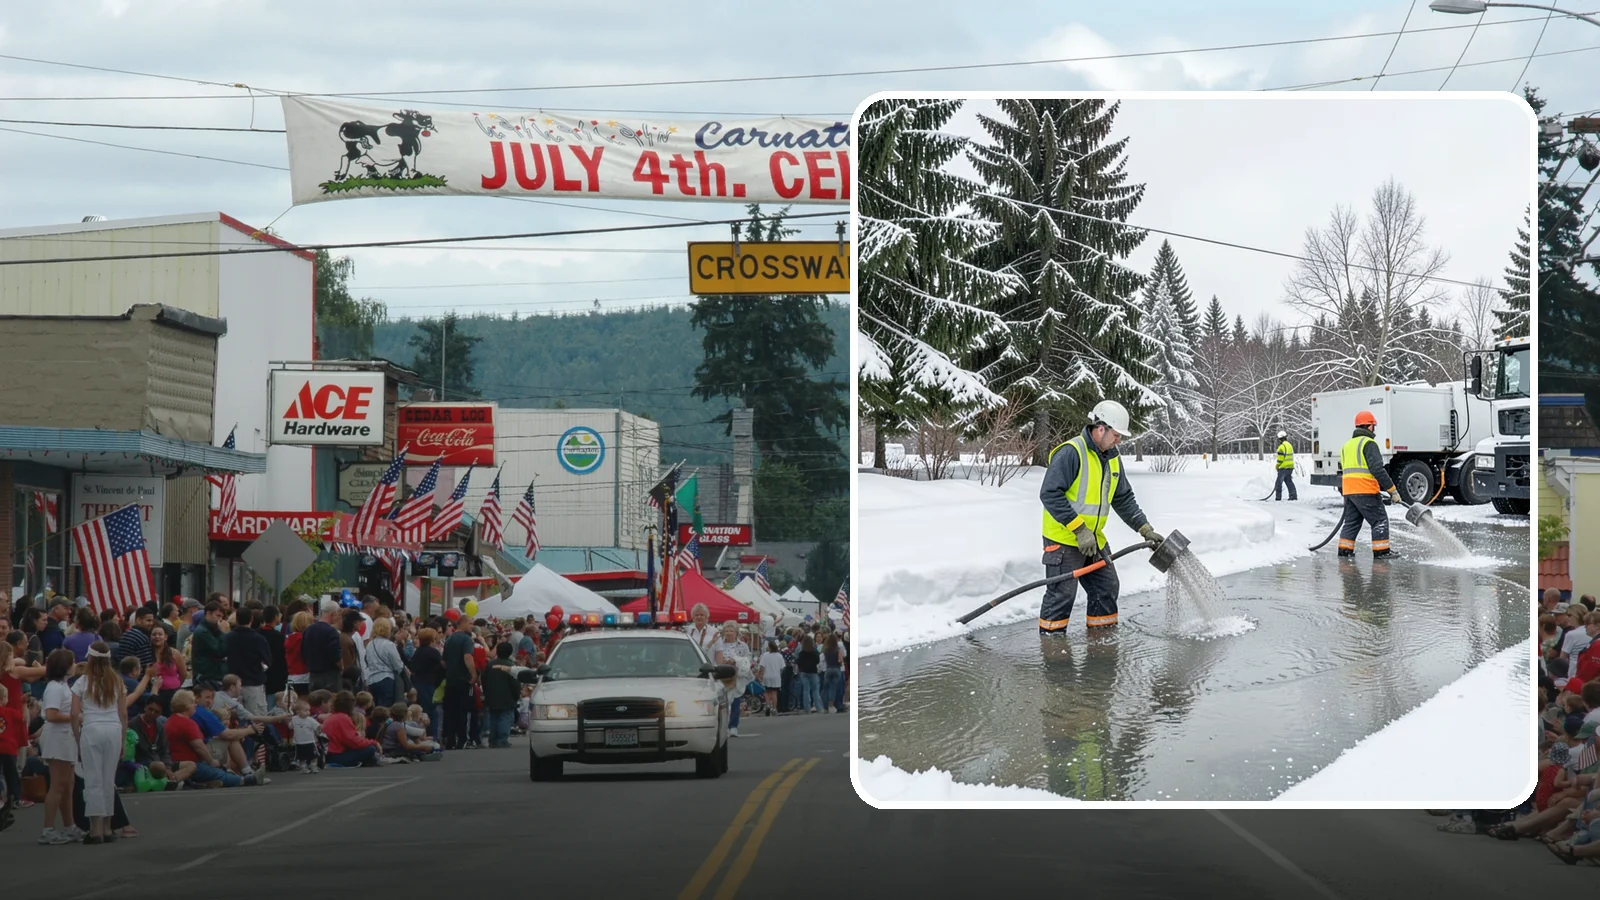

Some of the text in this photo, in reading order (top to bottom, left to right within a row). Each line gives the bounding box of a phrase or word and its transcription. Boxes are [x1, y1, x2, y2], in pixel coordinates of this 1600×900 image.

[481, 140, 604, 193] JULY
[632, 149, 746, 197] 4th.
[697, 254, 850, 280] CROSSWA
[283, 380, 373, 420] ACE
[405, 409, 485, 421] CEDAR LOG
[283, 421, 370, 436] Hardware
[416, 428, 477, 447] Coca-Cola
[354, 467, 384, 480] Simpl
[83, 485, 155, 495] St. Vincent de Paul
[212, 516, 330, 535] HARDARE
[688, 526, 741, 535] CRNATION
[699, 535, 730, 543] GLASS
